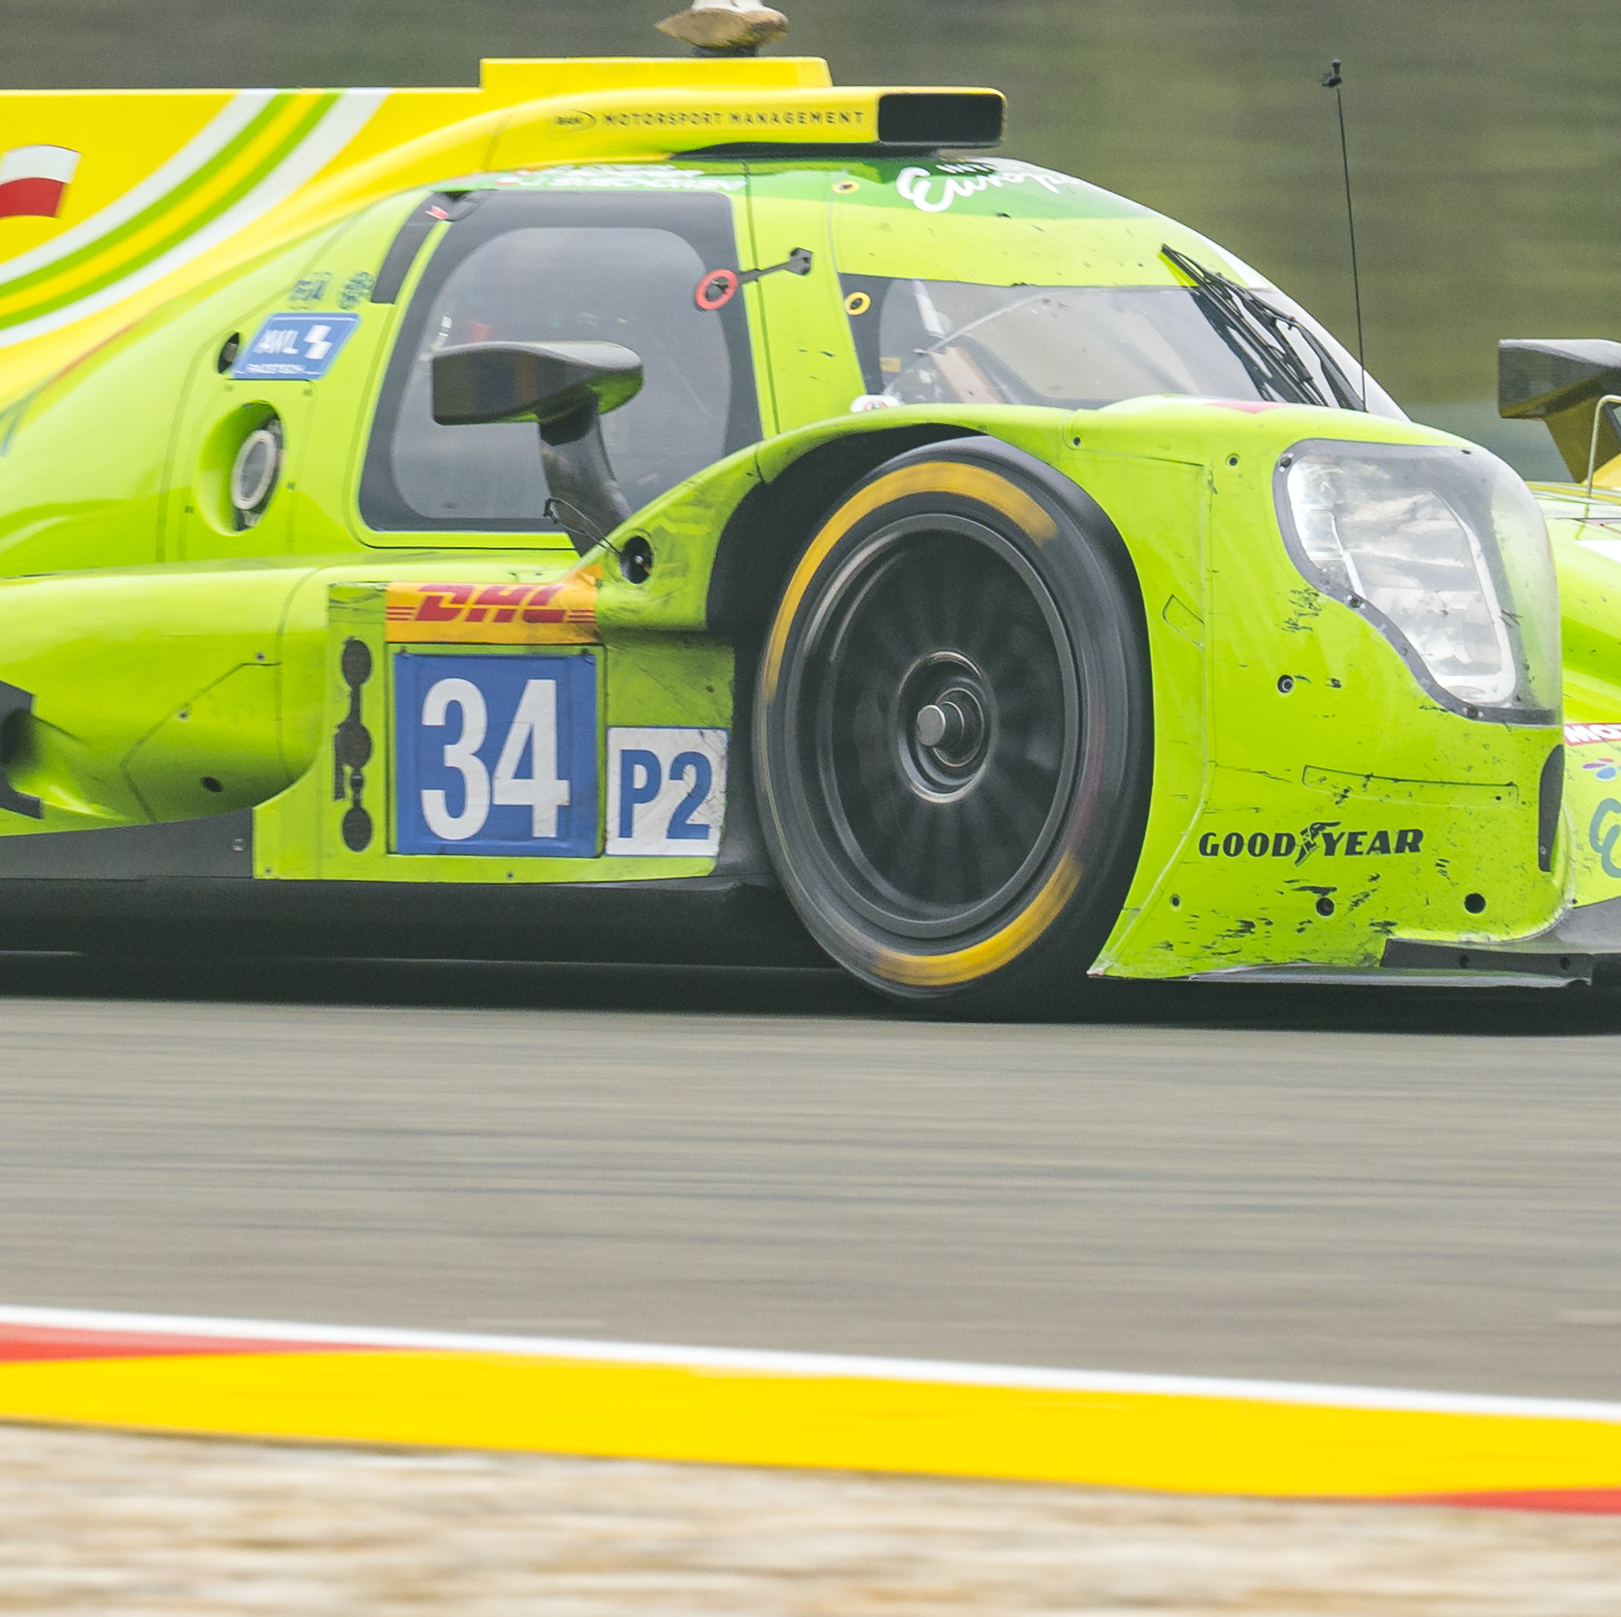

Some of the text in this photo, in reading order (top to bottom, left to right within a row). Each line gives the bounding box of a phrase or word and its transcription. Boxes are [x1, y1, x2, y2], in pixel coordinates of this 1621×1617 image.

[602, 111, 723, 126] MOTORSPORT
[728, 110, 865, 125] MANAGEMENT
[414, 583, 567, 623] DHL
[421, 678, 570, 840] 34
[619, 748, 713, 840] P2
[1198, 825, 1425, 860] GOODYEAR
